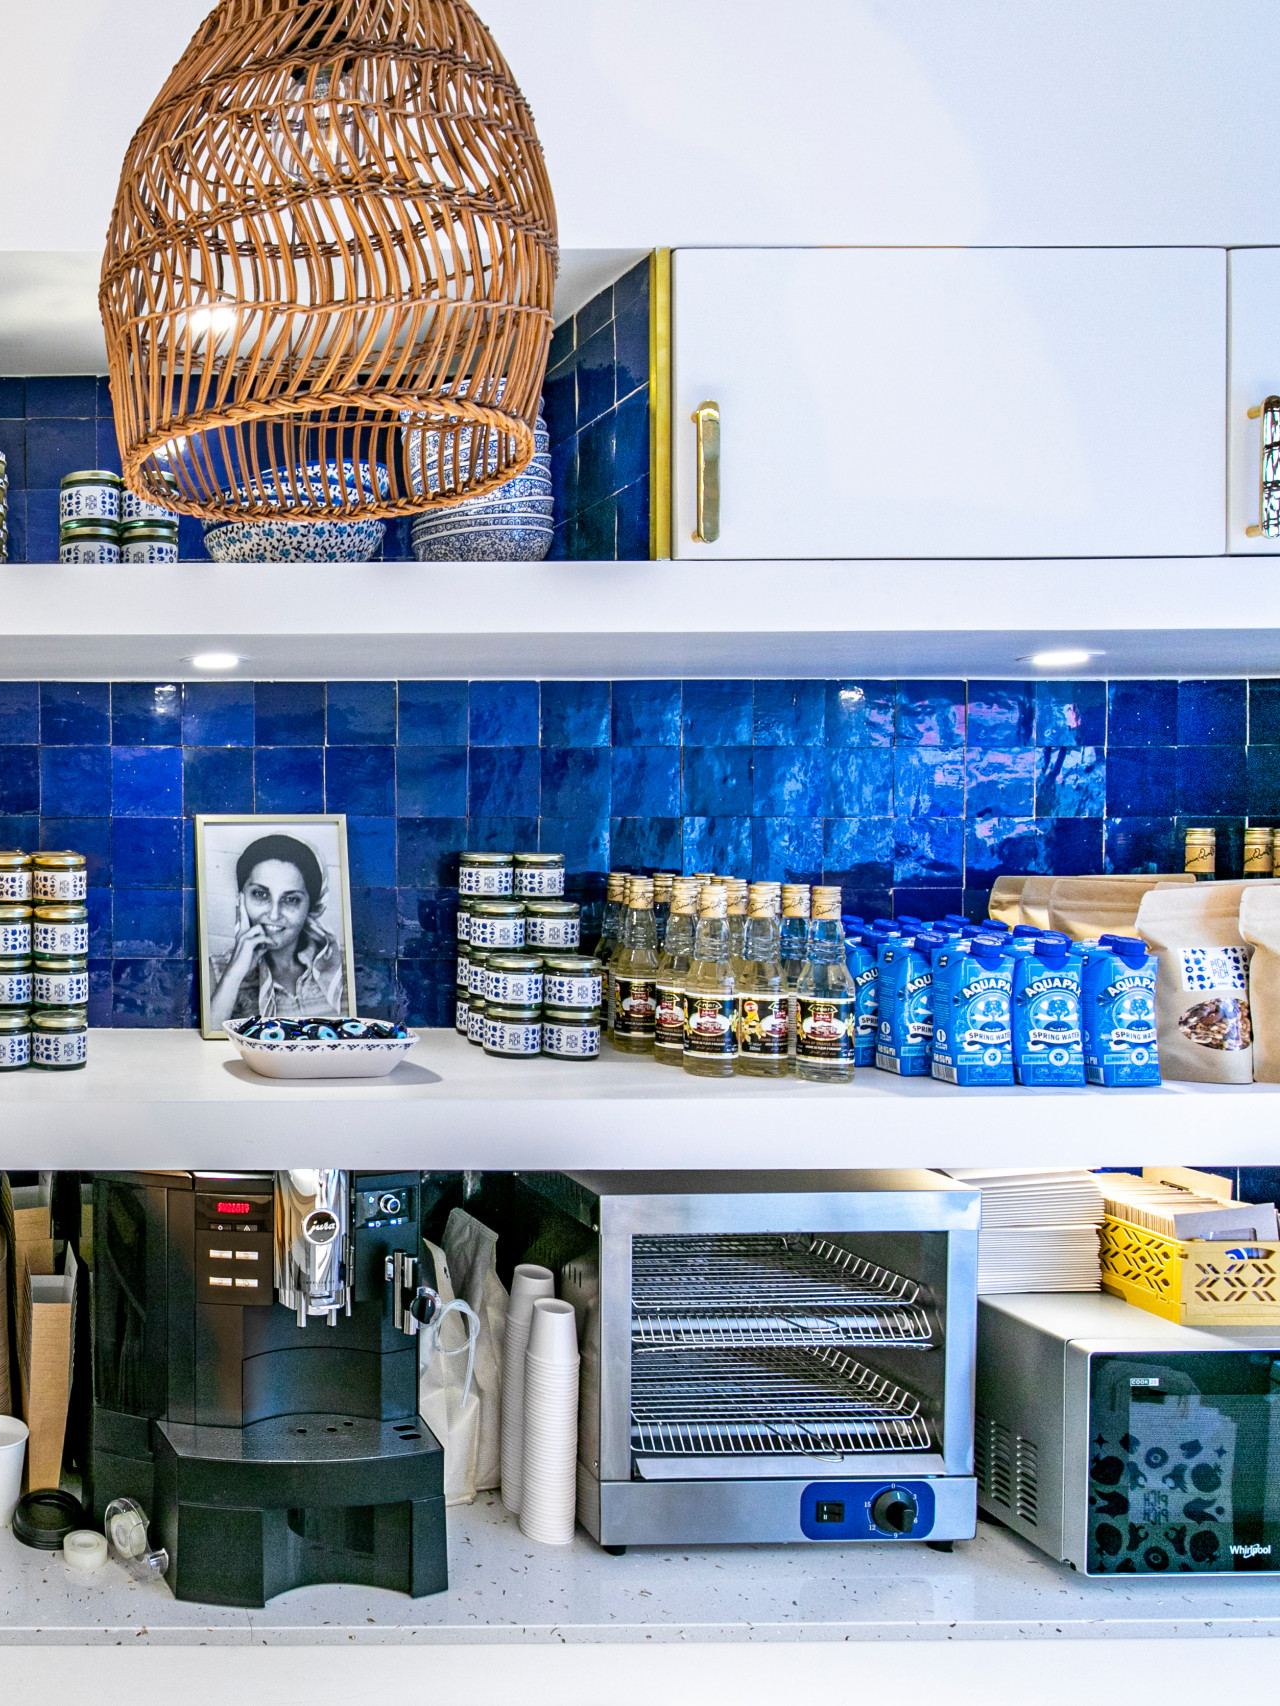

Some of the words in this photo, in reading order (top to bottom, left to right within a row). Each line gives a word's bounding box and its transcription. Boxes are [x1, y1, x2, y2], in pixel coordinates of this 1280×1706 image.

[856, 968, 878, 986] AQU
[907, 974, 932, 993] AQU
[1025, 978, 1081, 997] AQUAPAX
[1107, 977, 1156, 997] AQUAPA
[912, 1025, 933, 1033] SPRIN
[1033, 1032, 1059, 1040] SPRING
[1062, 1032, 1080, 1040] WATER
[1116, 1032, 1140, 1040] SPRING
[969, 1032, 994, 1041] SPRING
[307, 1220, 336, 1235] jura
[1230, 1544, 1272, 1558] Whirlpool
